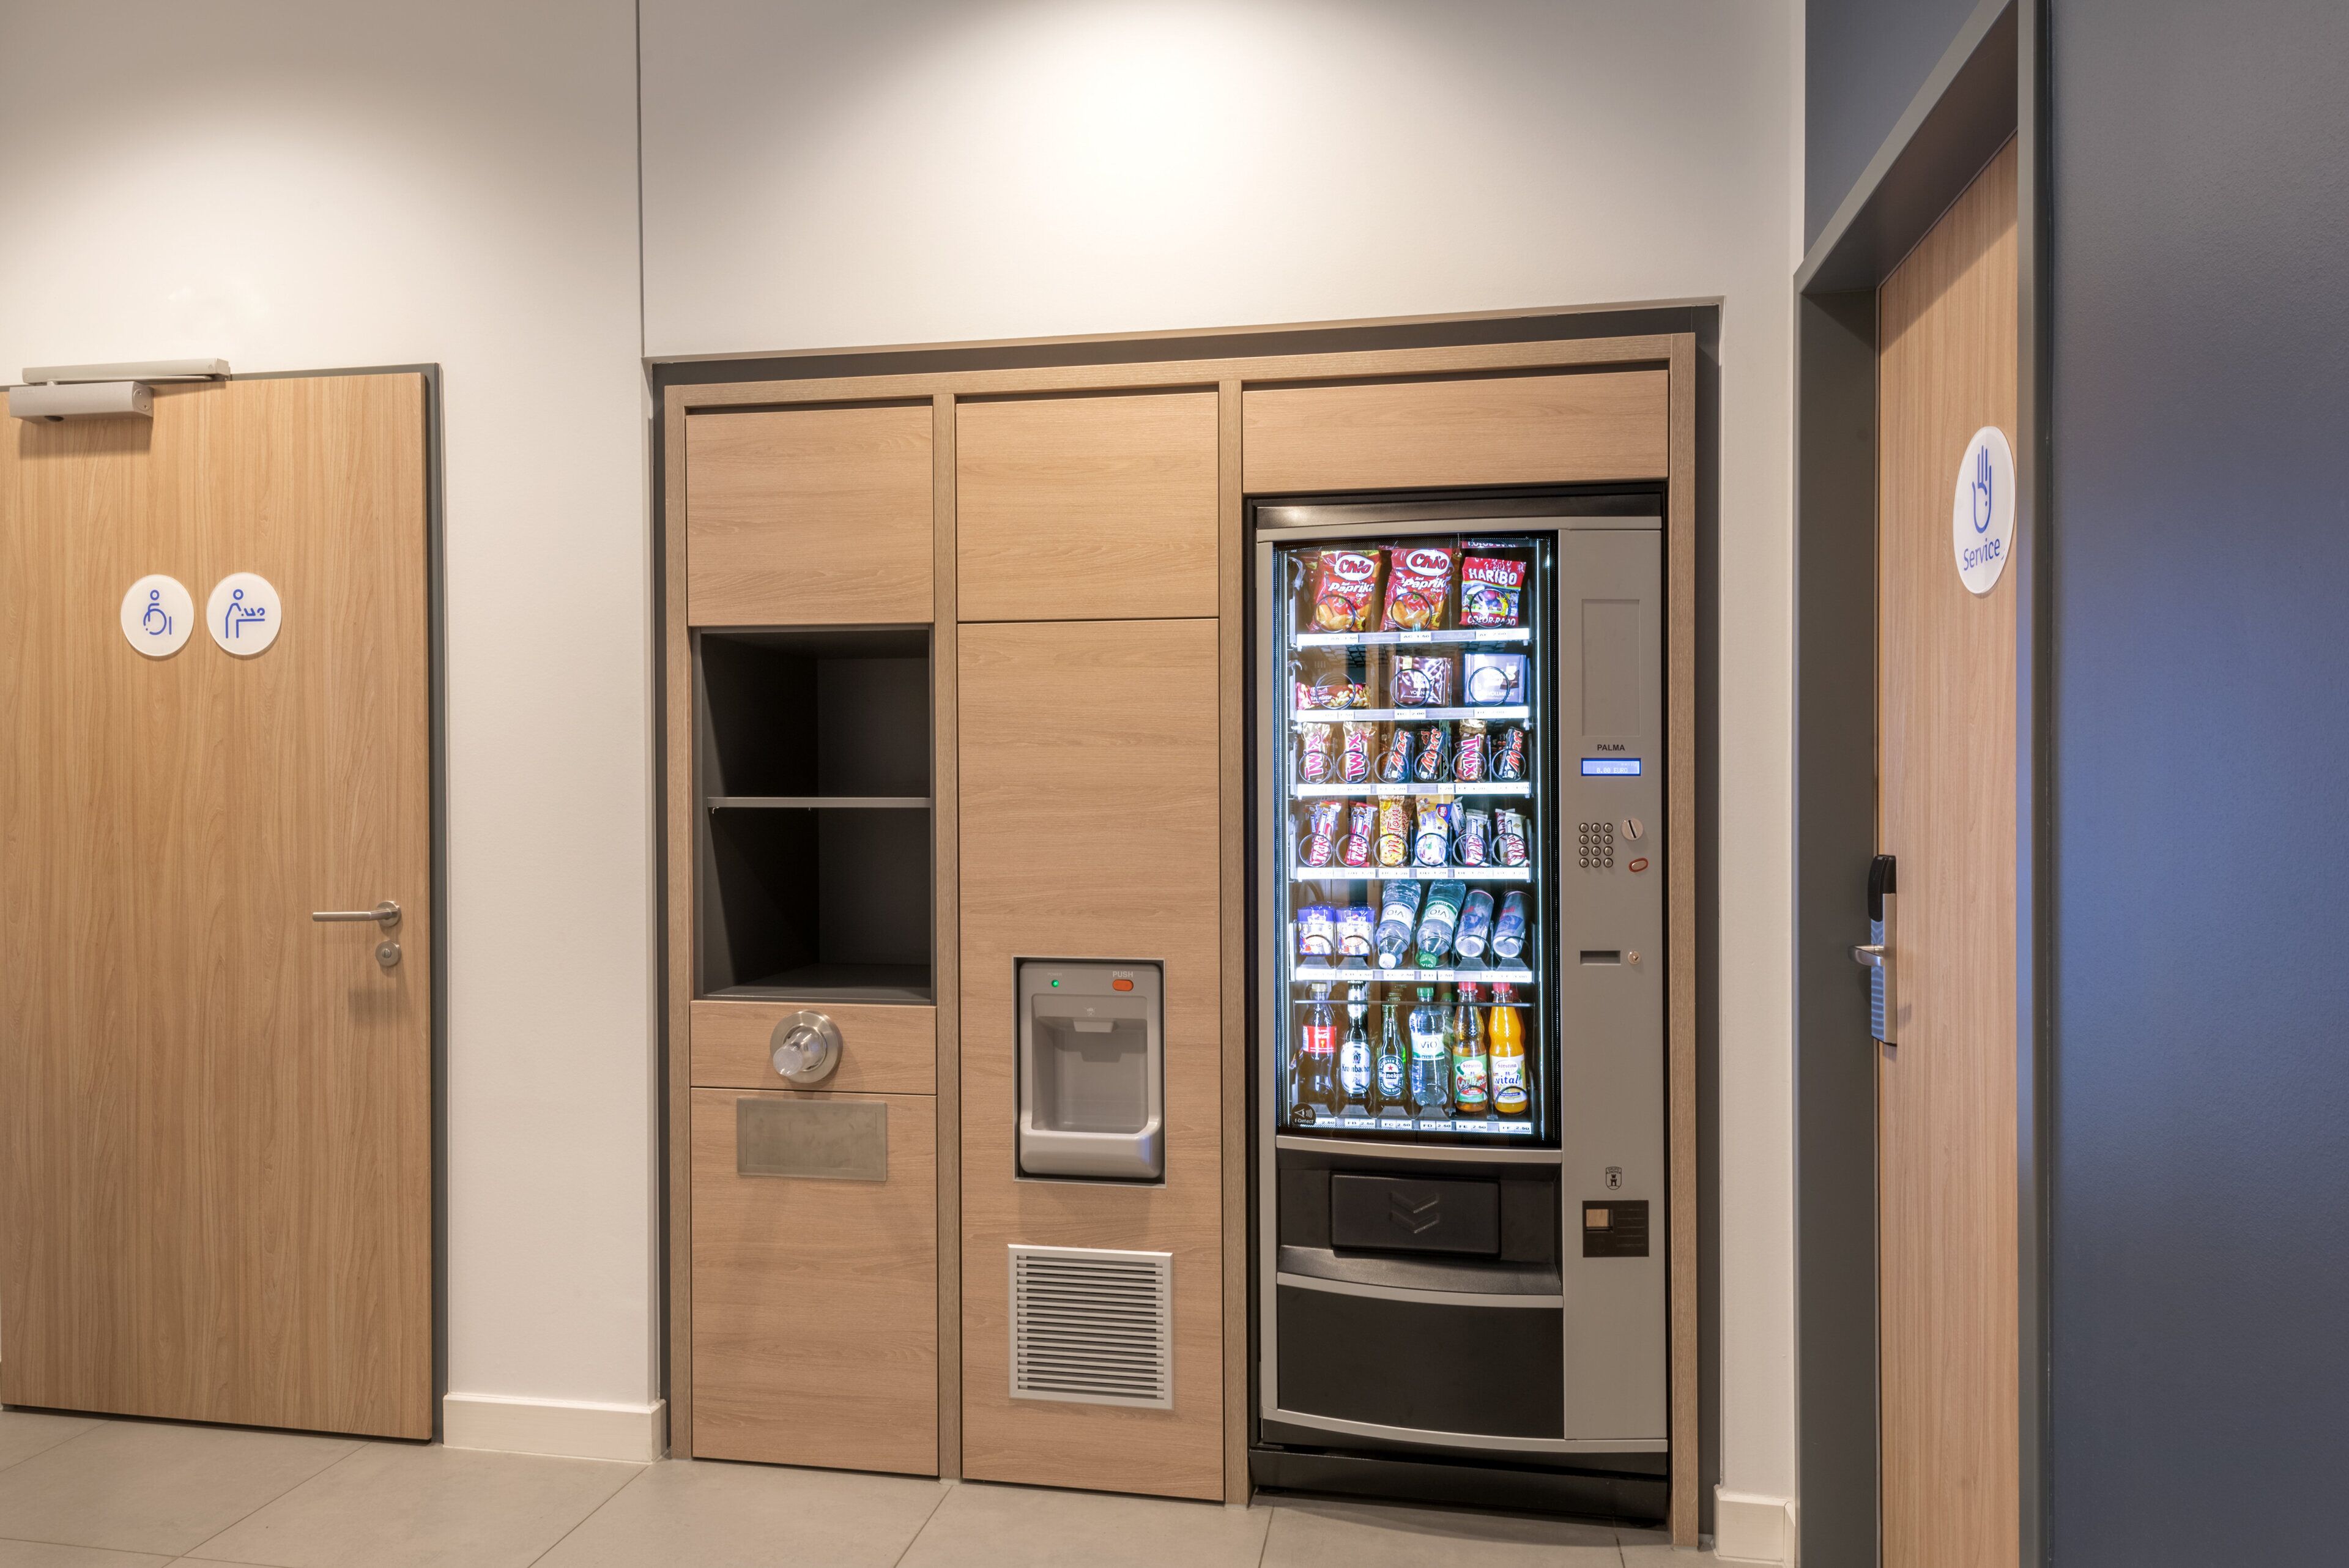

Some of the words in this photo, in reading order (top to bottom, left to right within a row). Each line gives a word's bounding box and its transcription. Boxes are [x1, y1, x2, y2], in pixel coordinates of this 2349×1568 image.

[1411, 553, 1447, 570] Chio
[1963, 538, 2000, 571] Service
[1339, 559, 1372, 573] Chio
[1402, 578, 1445, 590] Paprik
[1468, 568, 1518, 585] HARIBO
[1420, 728, 1442, 774] Mars
[1496, 1075, 1519, 1084] vital
